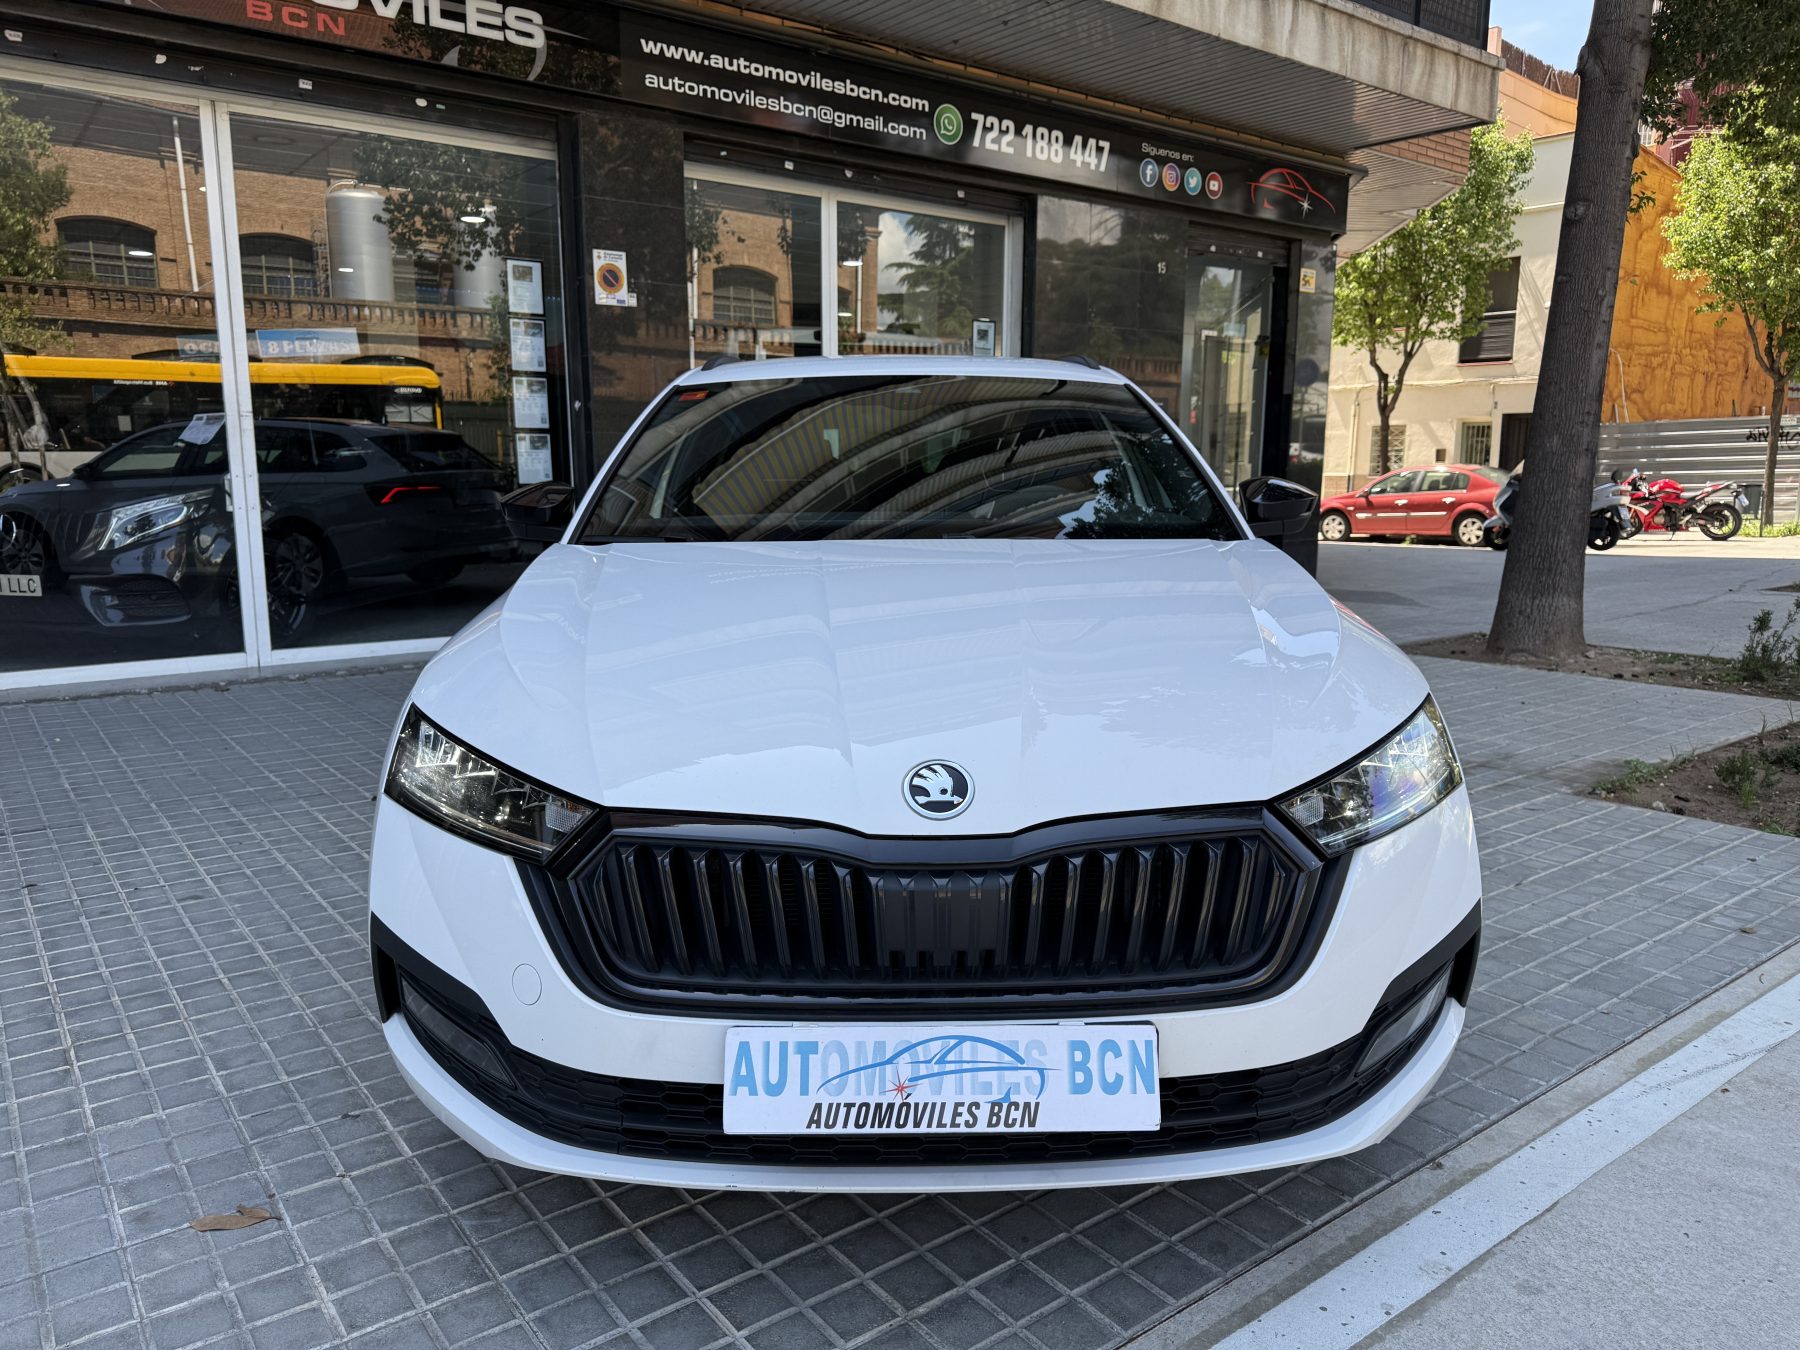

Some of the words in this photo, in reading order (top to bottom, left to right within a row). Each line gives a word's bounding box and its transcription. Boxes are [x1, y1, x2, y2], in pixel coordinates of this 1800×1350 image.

[246, 0, 345, 36] BCN
[640, 37, 930, 113] www.automovilesbcn.com
[644, 72, 927, 140] automovilesbcn@gmail.com
[970, 112, 1015, 154] 722
[1021, 123, 1064, 163] 188
[1069, 134, 1110, 172] 447
[1141, 142, 1181, 160] Síguenos
[1181, 153, 1194, 162] en:
[1157, 261, 1166, 274] 15
[8, 577, 36, 593] LLC
[728, 1039, 1049, 1097] AUTOMOVILES
[1068, 1038, 1155, 1096] BCN
[806, 1092, 980, 1129] AUTOMÓVILES
[986, 1101, 1040, 1129] BCN
